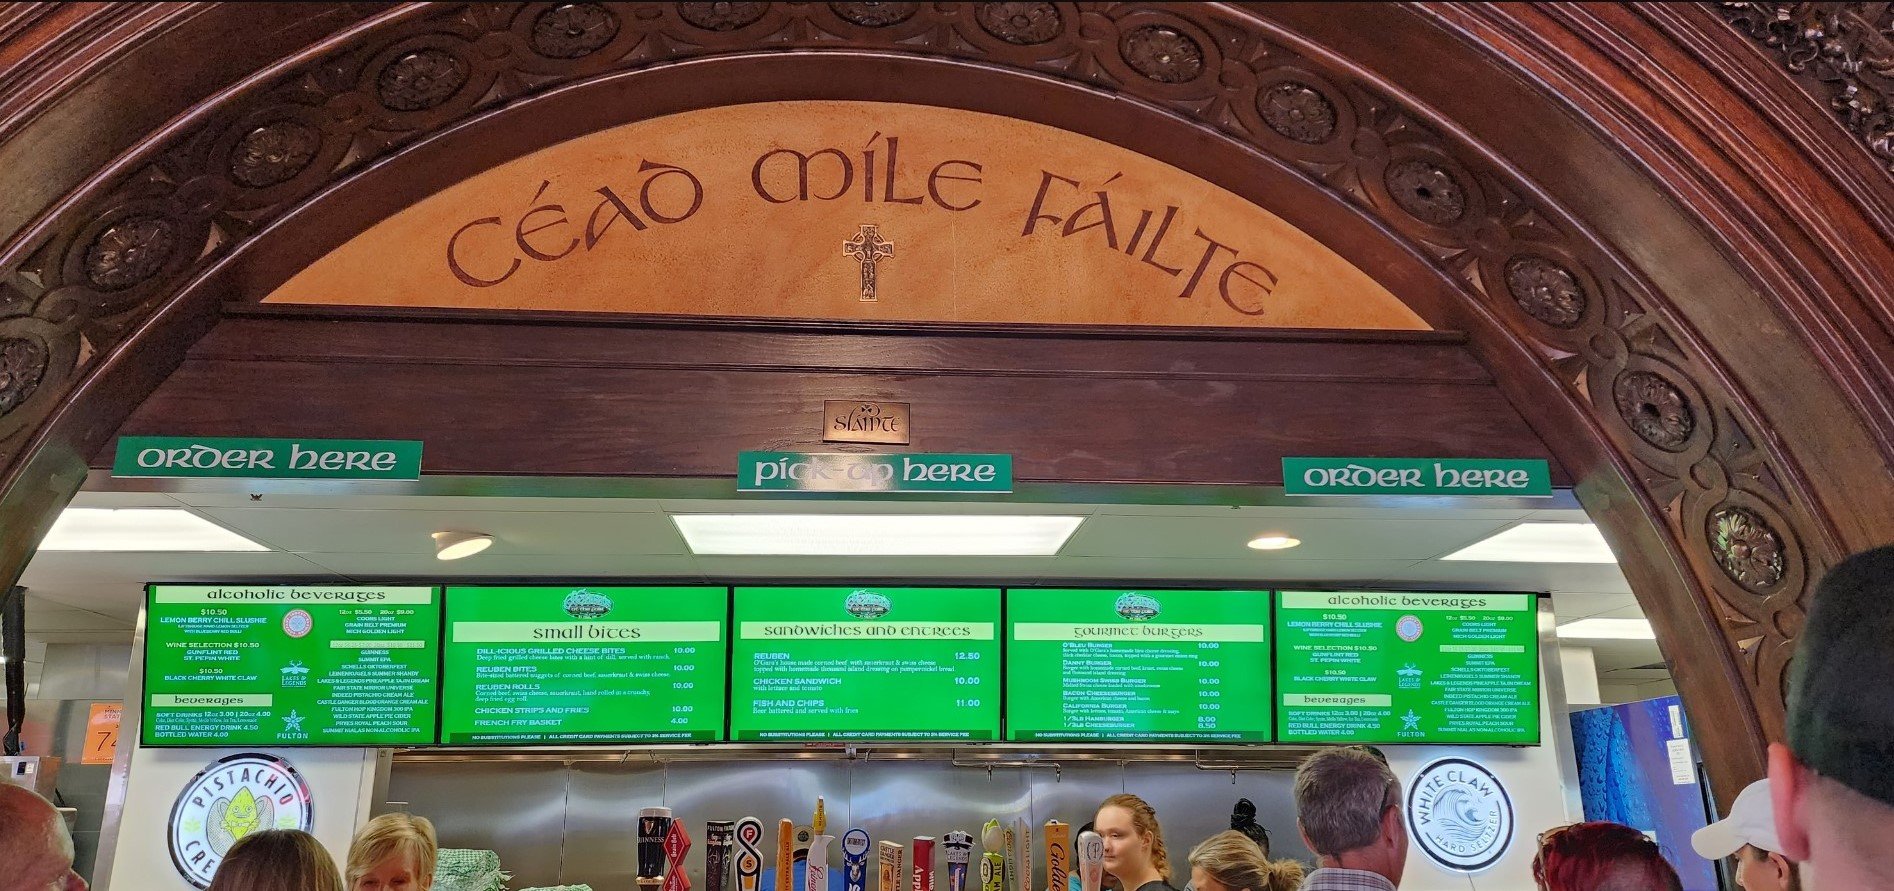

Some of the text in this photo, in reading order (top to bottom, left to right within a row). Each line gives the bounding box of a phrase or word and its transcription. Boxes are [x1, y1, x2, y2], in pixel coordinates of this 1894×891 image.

[447, 130, 1279, 316] CÉAD MÍLE FÁILTE
[137, 443, 397, 470] order here
[903, 457, 996, 482] here
[1303, 463, 1529, 488] order here
[207, 589, 386, 602] alcoholic beverages
[1328, 595, 1486, 609] alcoholic beverages
[533, 624, 641, 639] small bites
[764, 624, 971, 637] sandwiches and entrees
[1074, 626, 1202, 638] gourmet burgers
[955, 652, 980, 660] 12.50
[955, 677, 980, 685] 10.00
[174, 696, 244, 705] beverages
[1304, 696, 1366, 705] beverages
[192, 768, 293, 808] PISTACHIO
[1418, 771, 1494, 825] WHITE CLAW
[1436, 810, 1498, 852] HARD SELTZER
